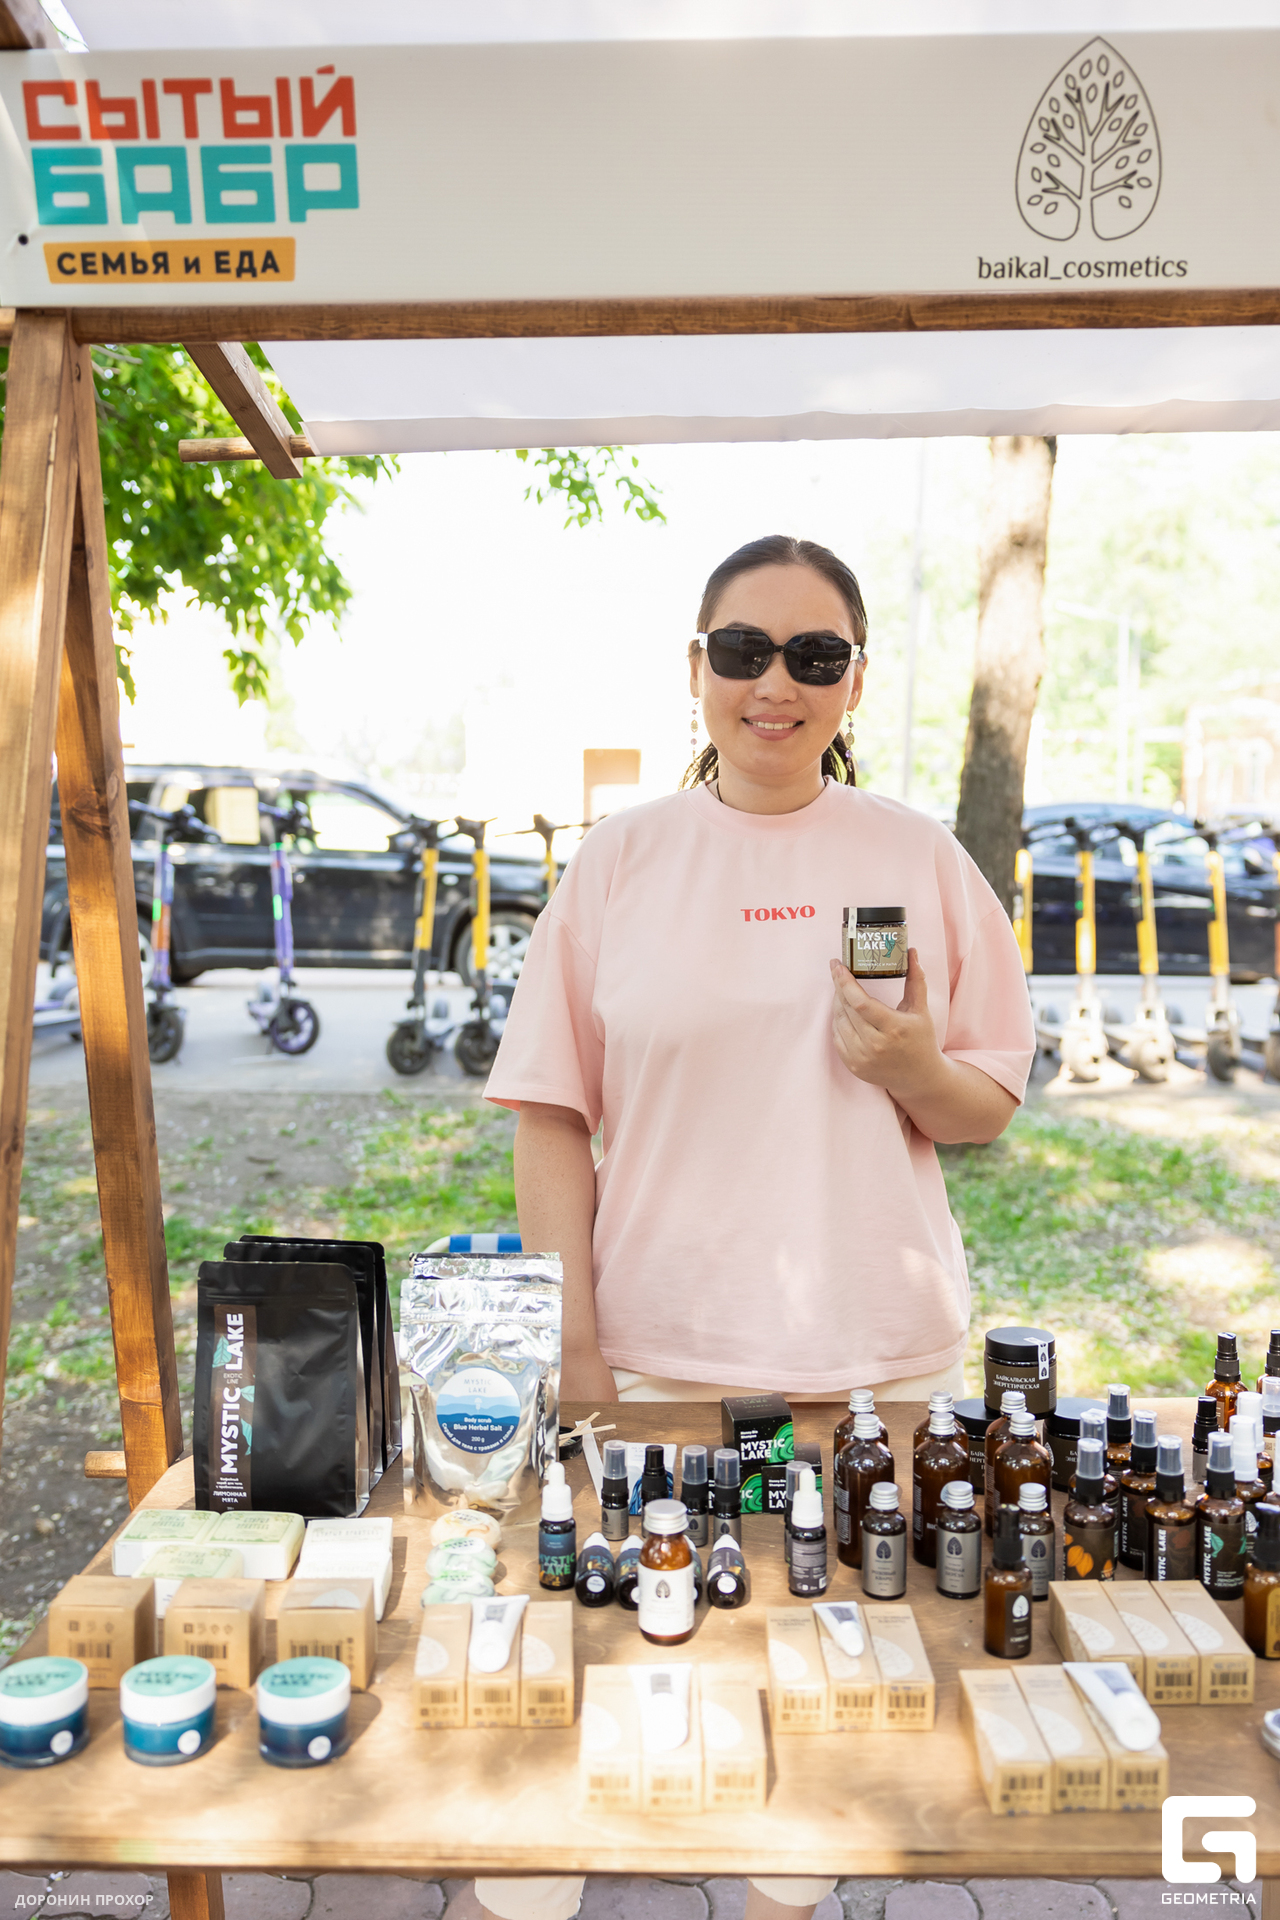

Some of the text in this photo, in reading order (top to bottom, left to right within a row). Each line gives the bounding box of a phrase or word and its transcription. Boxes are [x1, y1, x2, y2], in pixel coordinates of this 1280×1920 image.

[22, 64, 357, 141] СЫТЫЙ
[30, 143, 360, 226] БАБР
[57, 250, 170, 276] СЕМЬЯ
[214, 249, 280, 279] ЕДА
[977, 255, 1189, 281] baikal_cosmetics
[740, 905, 816, 922] TOKYO
[857, 931, 898, 941] MYSTIC
[857, 941, 886, 950] LAKE
[220, 1313, 245, 1475] MYSTIC LAKE
[740, 1438, 786, 1452] MYSTIC
[741, 1449, 772, 1461] LAKE
[1158, 1529, 1167, 1581] YSTIC LAKE
[1203, 1525, 1212, 1586] MYSTIC LAKE
